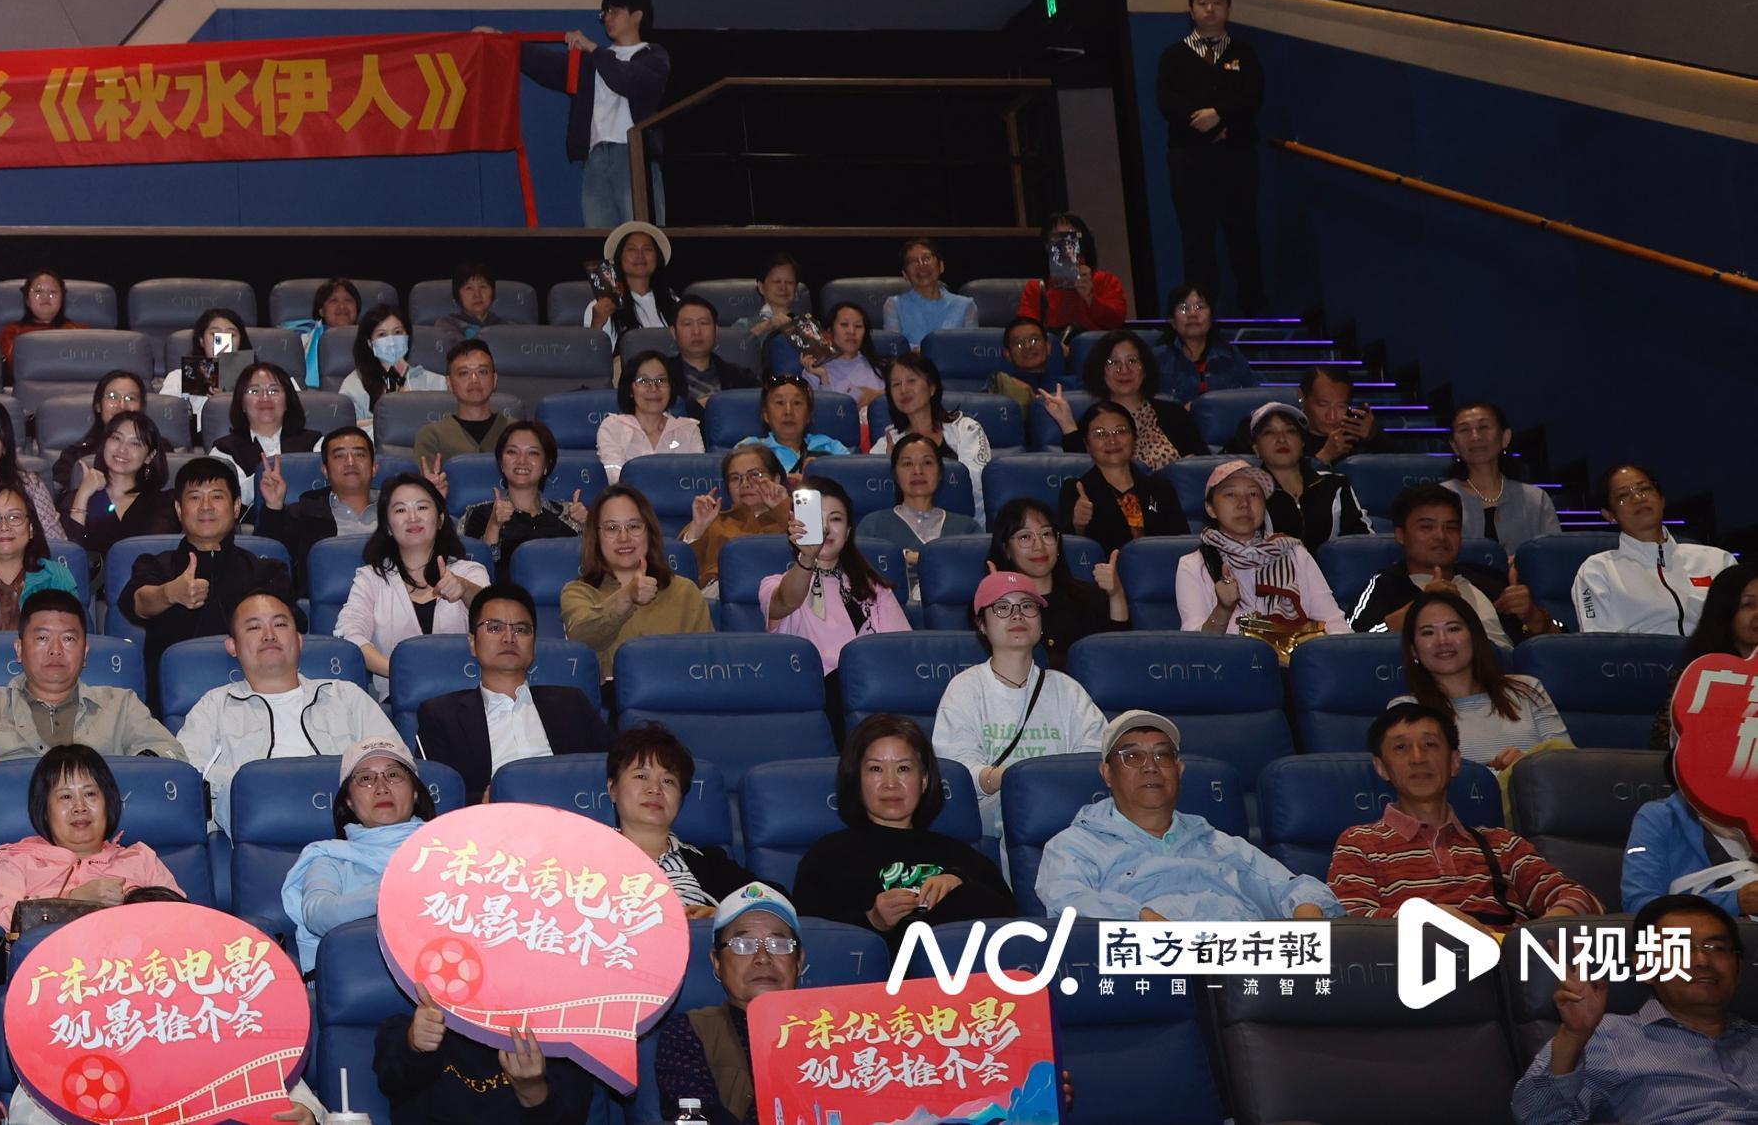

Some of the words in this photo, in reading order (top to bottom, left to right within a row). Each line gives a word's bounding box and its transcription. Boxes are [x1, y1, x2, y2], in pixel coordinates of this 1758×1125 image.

[95, 292, 104, 304] 8
[171, 296, 219, 308] CINITY
[128, 342, 137, 354] 8
[281, 339, 288, 351] 7
[435, 340, 443, 352] 6
[521, 343, 570, 356] CINITY
[59, 348, 109, 362] CINITY
[164, 408, 173, 420] 8
[330, 405, 338, 418] 7
[503, 407, 511, 419] 6
[836, 406, 845, 417] 4
[1000, 407, 1008, 420] 3
[581, 469, 590, 484] 6
[949, 473, 959, 488] 4
[58, 555, 68, 569] 9
[669, 554, 678, 570] 6
[878, 555, 888, 571] 5
[1079, 552, 1090, 567] 4
[1582, 587, 1596, 619] CHINA
[111, 655, 122, 673] 9
[330, 657, 342, 675] 8
[568, 658, 578, 676] 7
[790, 654, 801, 672] 6
[1250, 652, 1262, 671] 4
[689, 662, 763, 680] CINITY
[1148, 664, 1223, 681] CINITY
[1601, 662, 1674, 679] CINITY
[165, 780, 177, 801] 9
[429, 782, 441, 803] 8
[693, 780, 706, 802] 7
[1211, 780, 1224, 802] 5
[1469, 783, 1483, 802] 4
[410, 837, 671, 939] 广东优秀电影
[417, 890, 641, 972] 观影推介会
[25, 935, 278, 1008] 广东优秀电影
[850, 951, 864, 976] 7
[48, 997, 265, 1056] 观影推介会
[776, 996, 1023, 1053] 广东优秀电影
[796, 1048, 1012, 1097] 观影推介会
